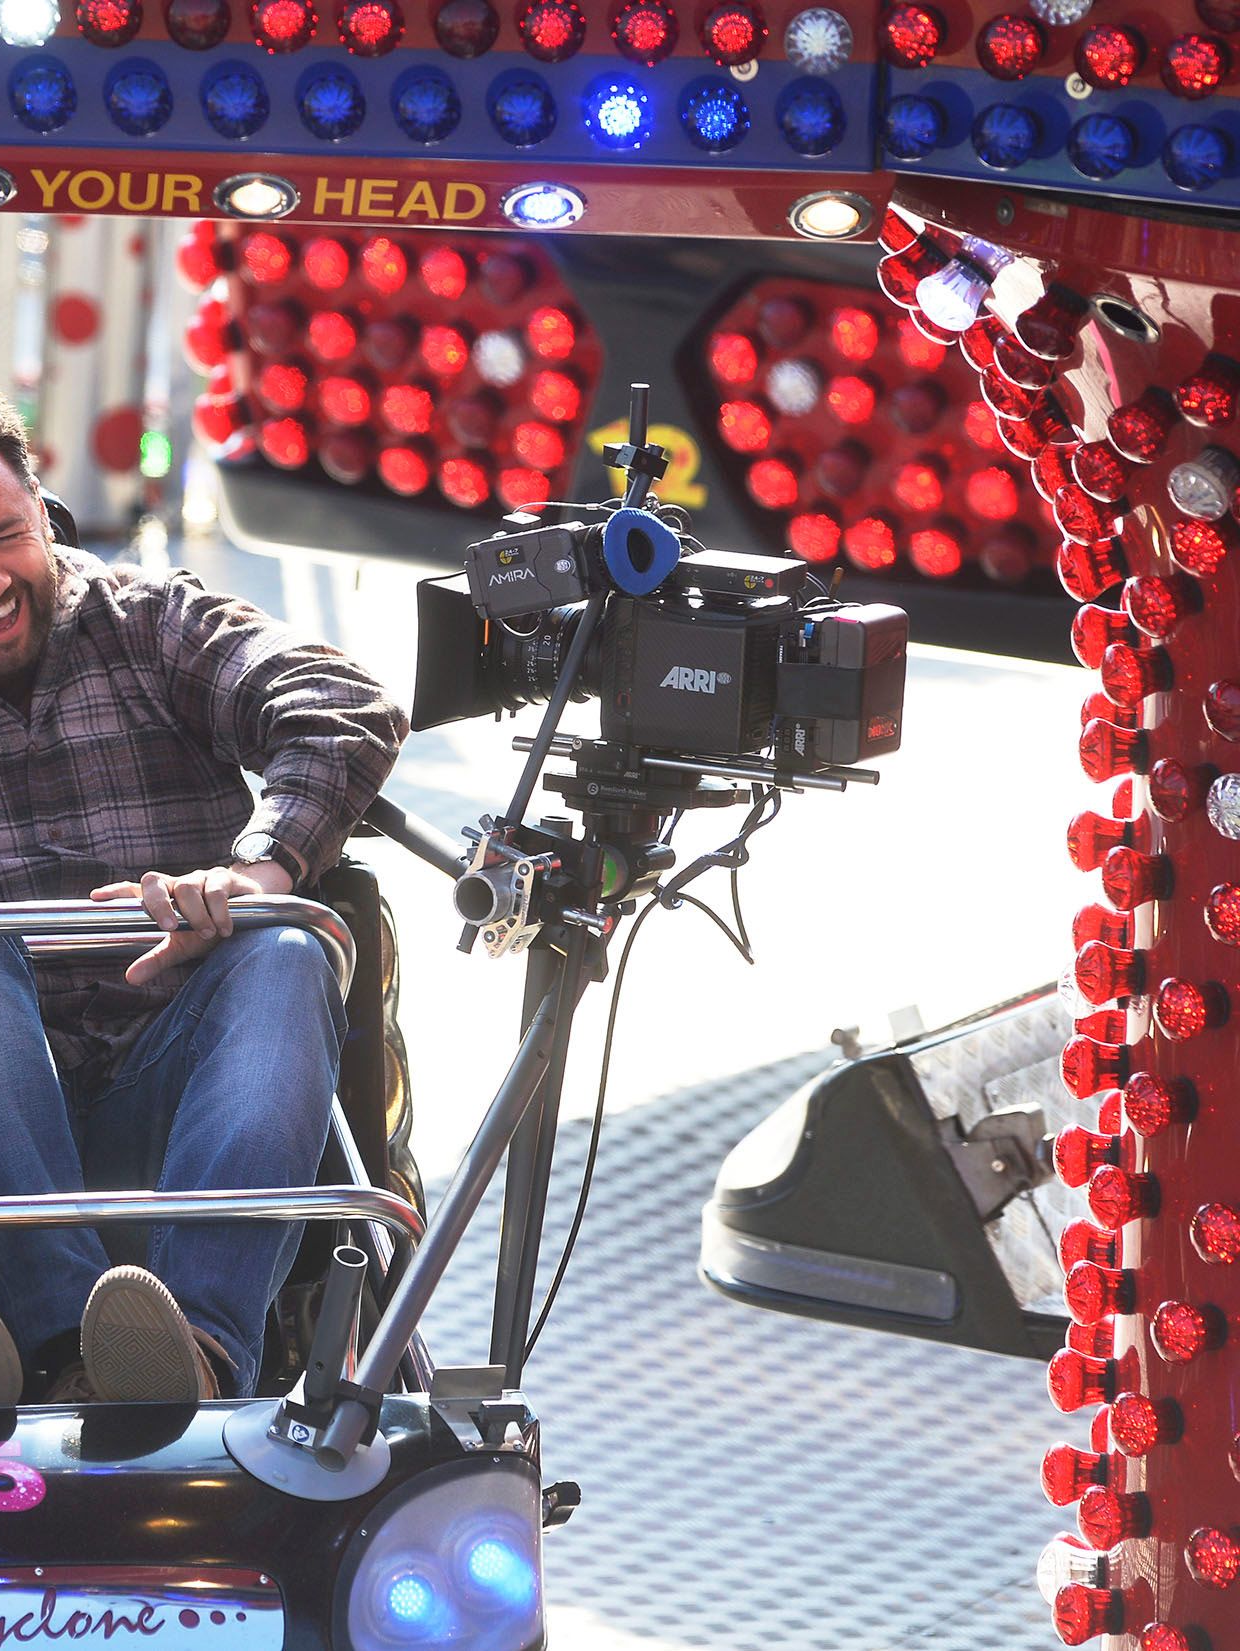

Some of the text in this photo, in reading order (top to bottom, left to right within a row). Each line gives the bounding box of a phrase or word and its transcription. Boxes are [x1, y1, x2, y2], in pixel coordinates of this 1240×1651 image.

[30, 168, 203, 213] YOUR
[312, 177, 487, 220] HEAD
[489, 567, 535, 586] AMIRA
[660, 666, 716, 694] ARRI
[795, 728, 806, 757] ARRI
